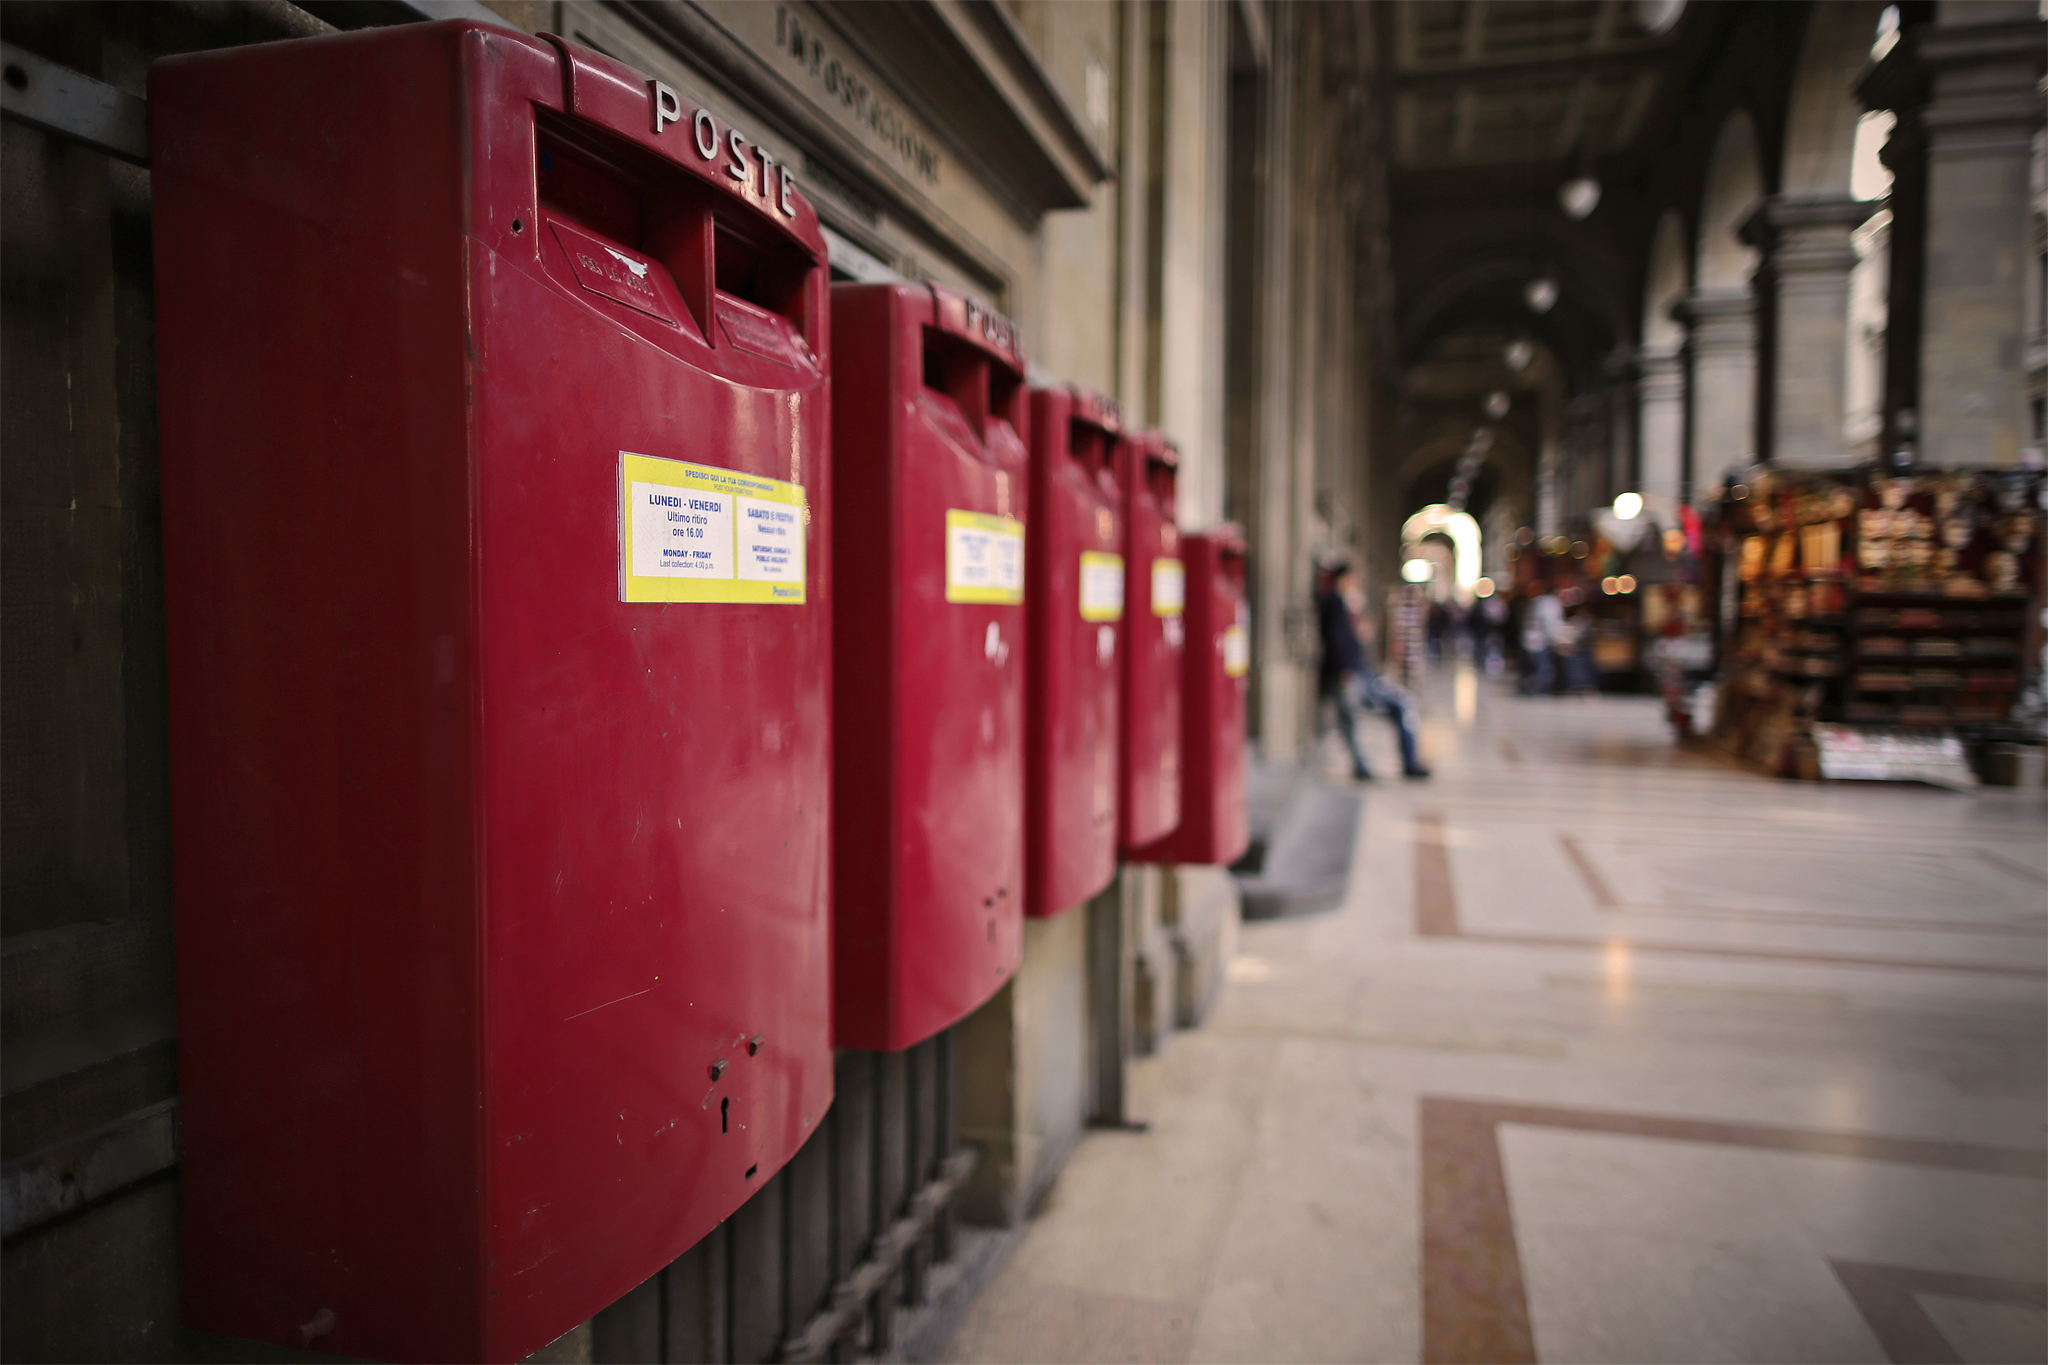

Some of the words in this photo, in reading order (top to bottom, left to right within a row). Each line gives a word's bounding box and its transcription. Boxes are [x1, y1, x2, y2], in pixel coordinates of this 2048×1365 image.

[648, 79, 797, 219] POSTE
[685, 469, 709, 480] SPEDISCI
[710, 473, 720, 482] QUI
[720, 475, 727, 483] LA
[728, 476, 737, 485] TUA
[649, 494, 682, 508] LUNEDI
[688, 499, 722, 513] VENERDI
[667, 510, 691, 524] Ultimo
[691, 513, 708, 525] ritiro
[747, 507, 770, 520] SABATO
[672, 528, 685, 537] ore
[686, 527, 704, 539] 16.00
[663, 549, 689, 558] MONDAY
[692, 550, 712, 560] FRIDAY
[659, 559, 671, 568] Last
[694, 561, 705, 570] 4.00
